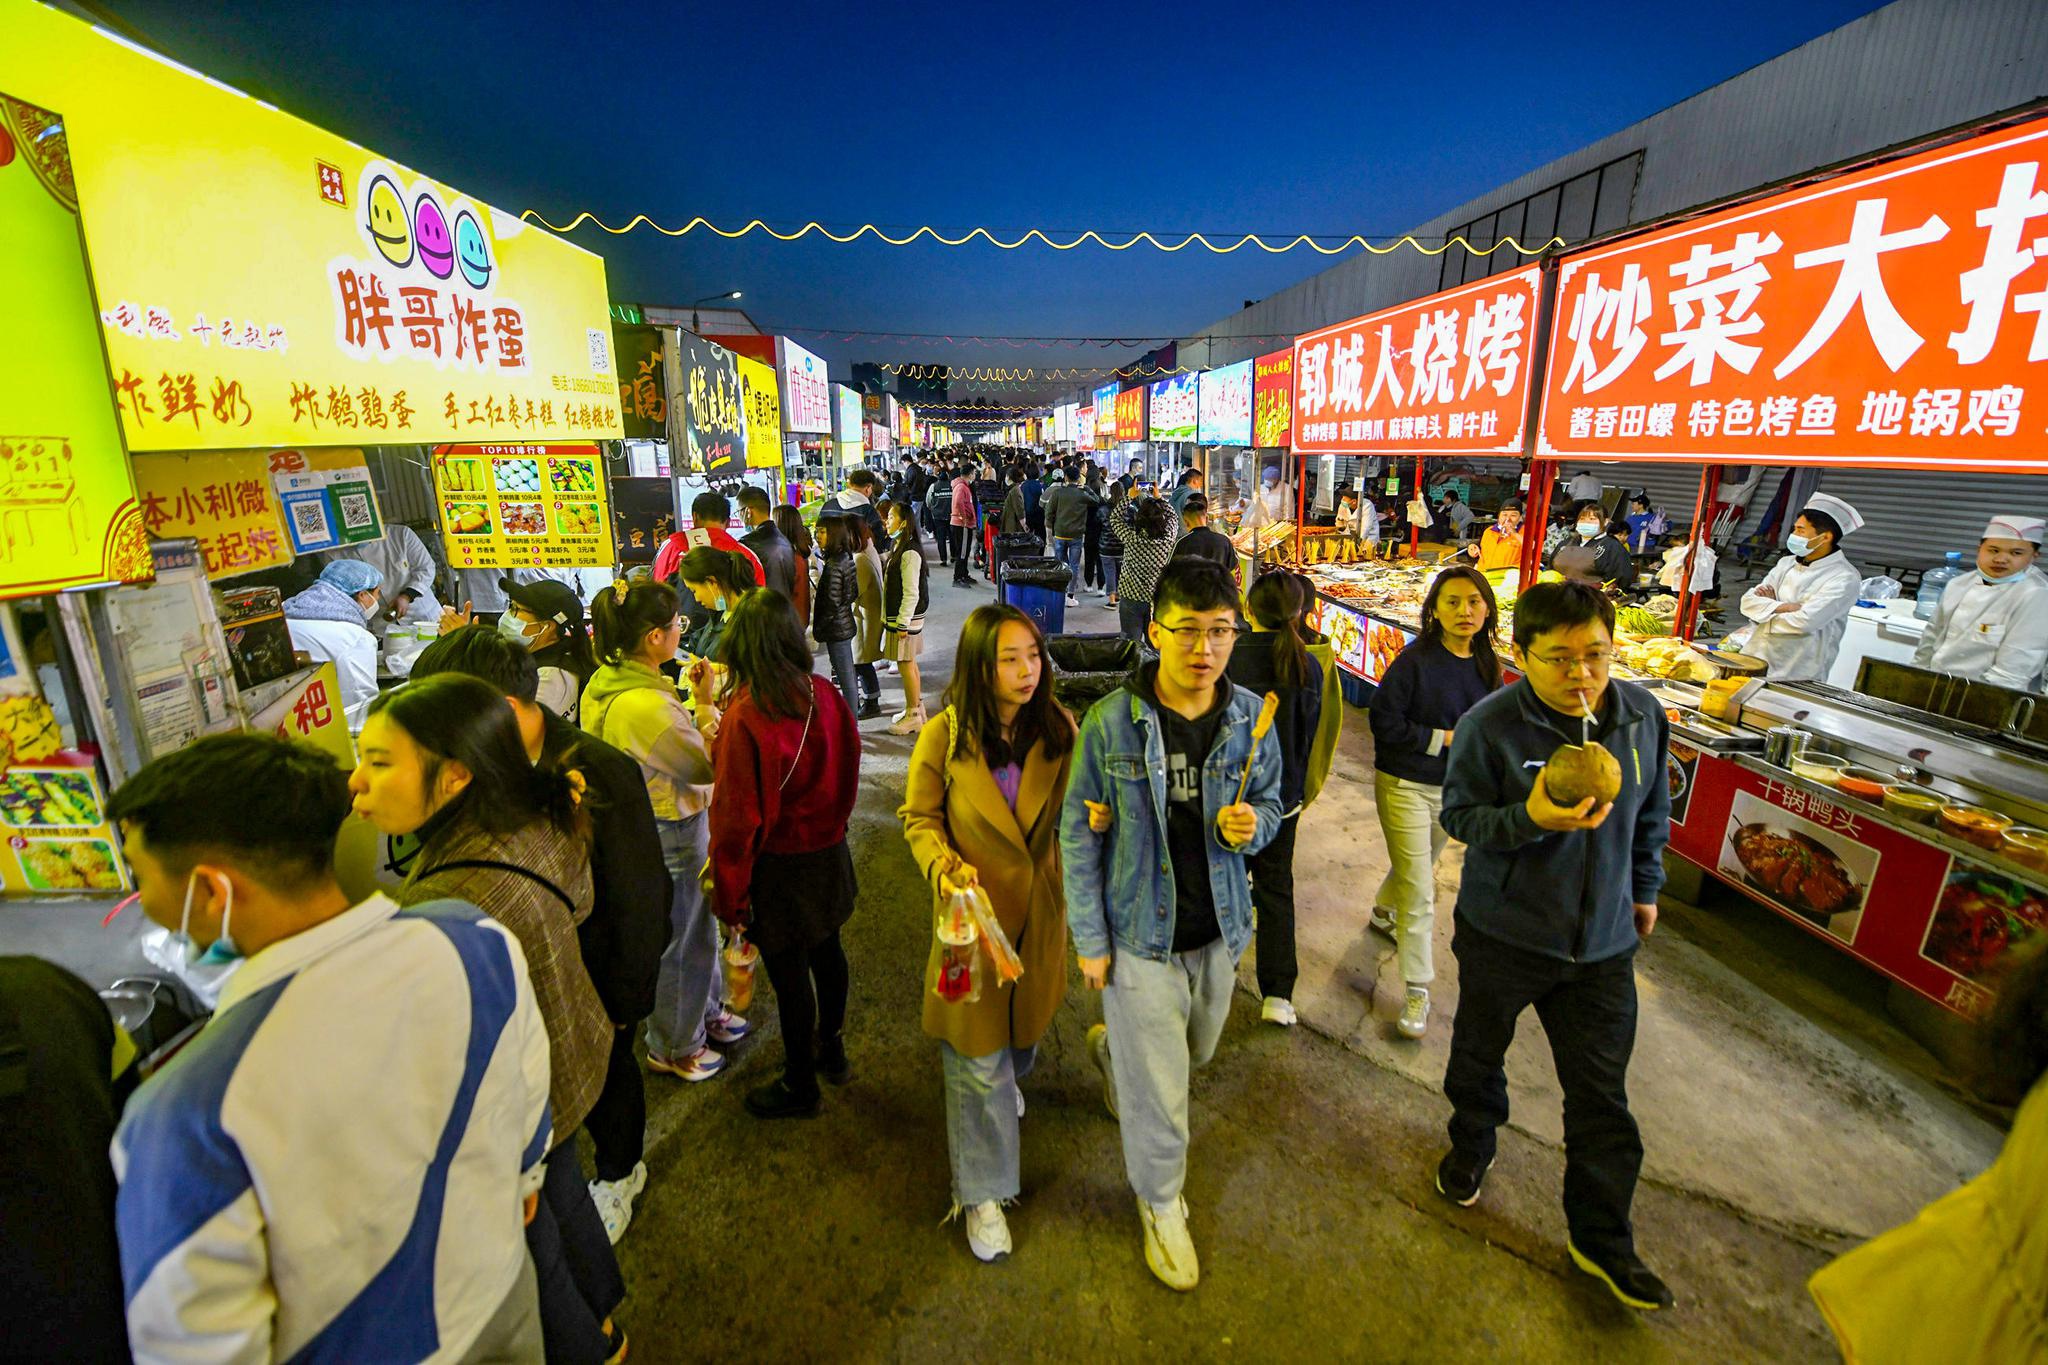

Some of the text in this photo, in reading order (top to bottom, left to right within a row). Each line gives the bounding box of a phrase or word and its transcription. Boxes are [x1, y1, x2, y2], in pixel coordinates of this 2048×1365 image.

[337, 268, 526, 367] 胖哥炸蛋
[1299, 293, 1526, 417] 郓城人烧烤
[289, 381, 416, 431] 炸鹌鹑蛋
[444, 391, 557, 431] 手工红枣年糕
[1302, 422, 1338, 443] 各种烤串
[1388, 414, 1442, 441] 麻辣鸭头
[1447, 409, 1499, 439] 涮牛肚
[1569, 384, 2024, 439] 酱香田螺 特色烤鱼 地锅鸡
[480, 446, 546, 455] TOP10排行榜
[140, 480, 269, 531] 本小利微
